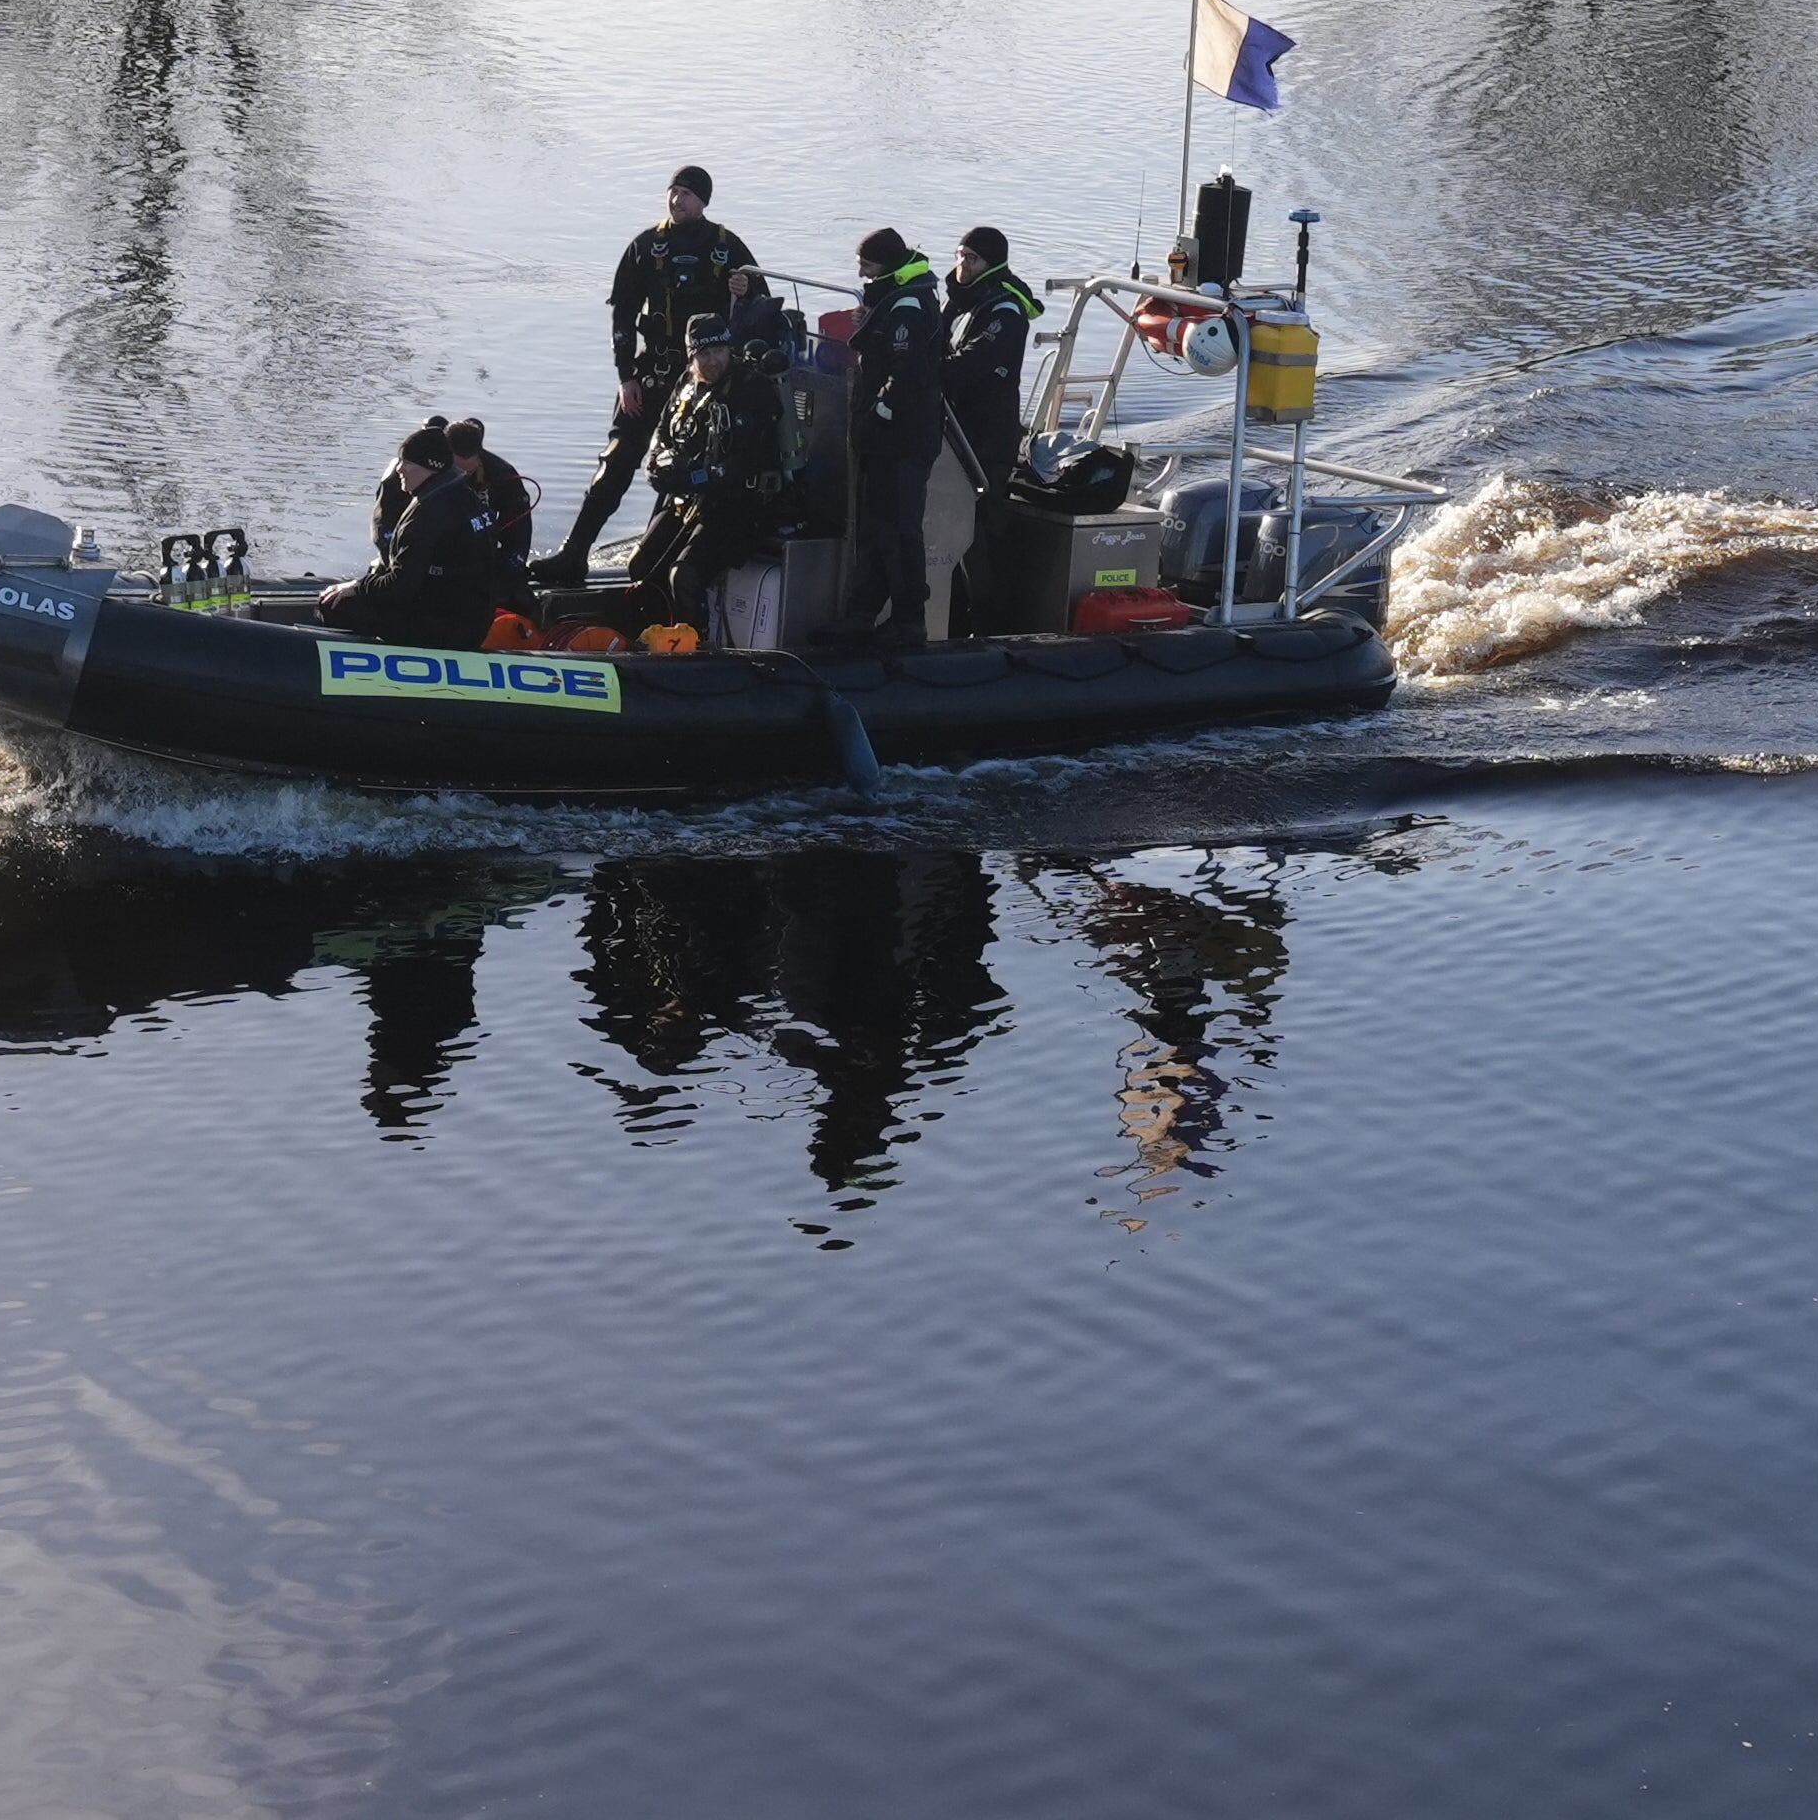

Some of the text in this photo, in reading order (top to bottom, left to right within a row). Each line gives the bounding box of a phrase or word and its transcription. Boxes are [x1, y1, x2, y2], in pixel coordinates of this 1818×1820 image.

[1161, 517, 1187, 532] 00
[1260, 541, 1287, 557] 100
[1101, 573, 1130, 582] POLICE
[329, 650, 609, 699] POLICE
